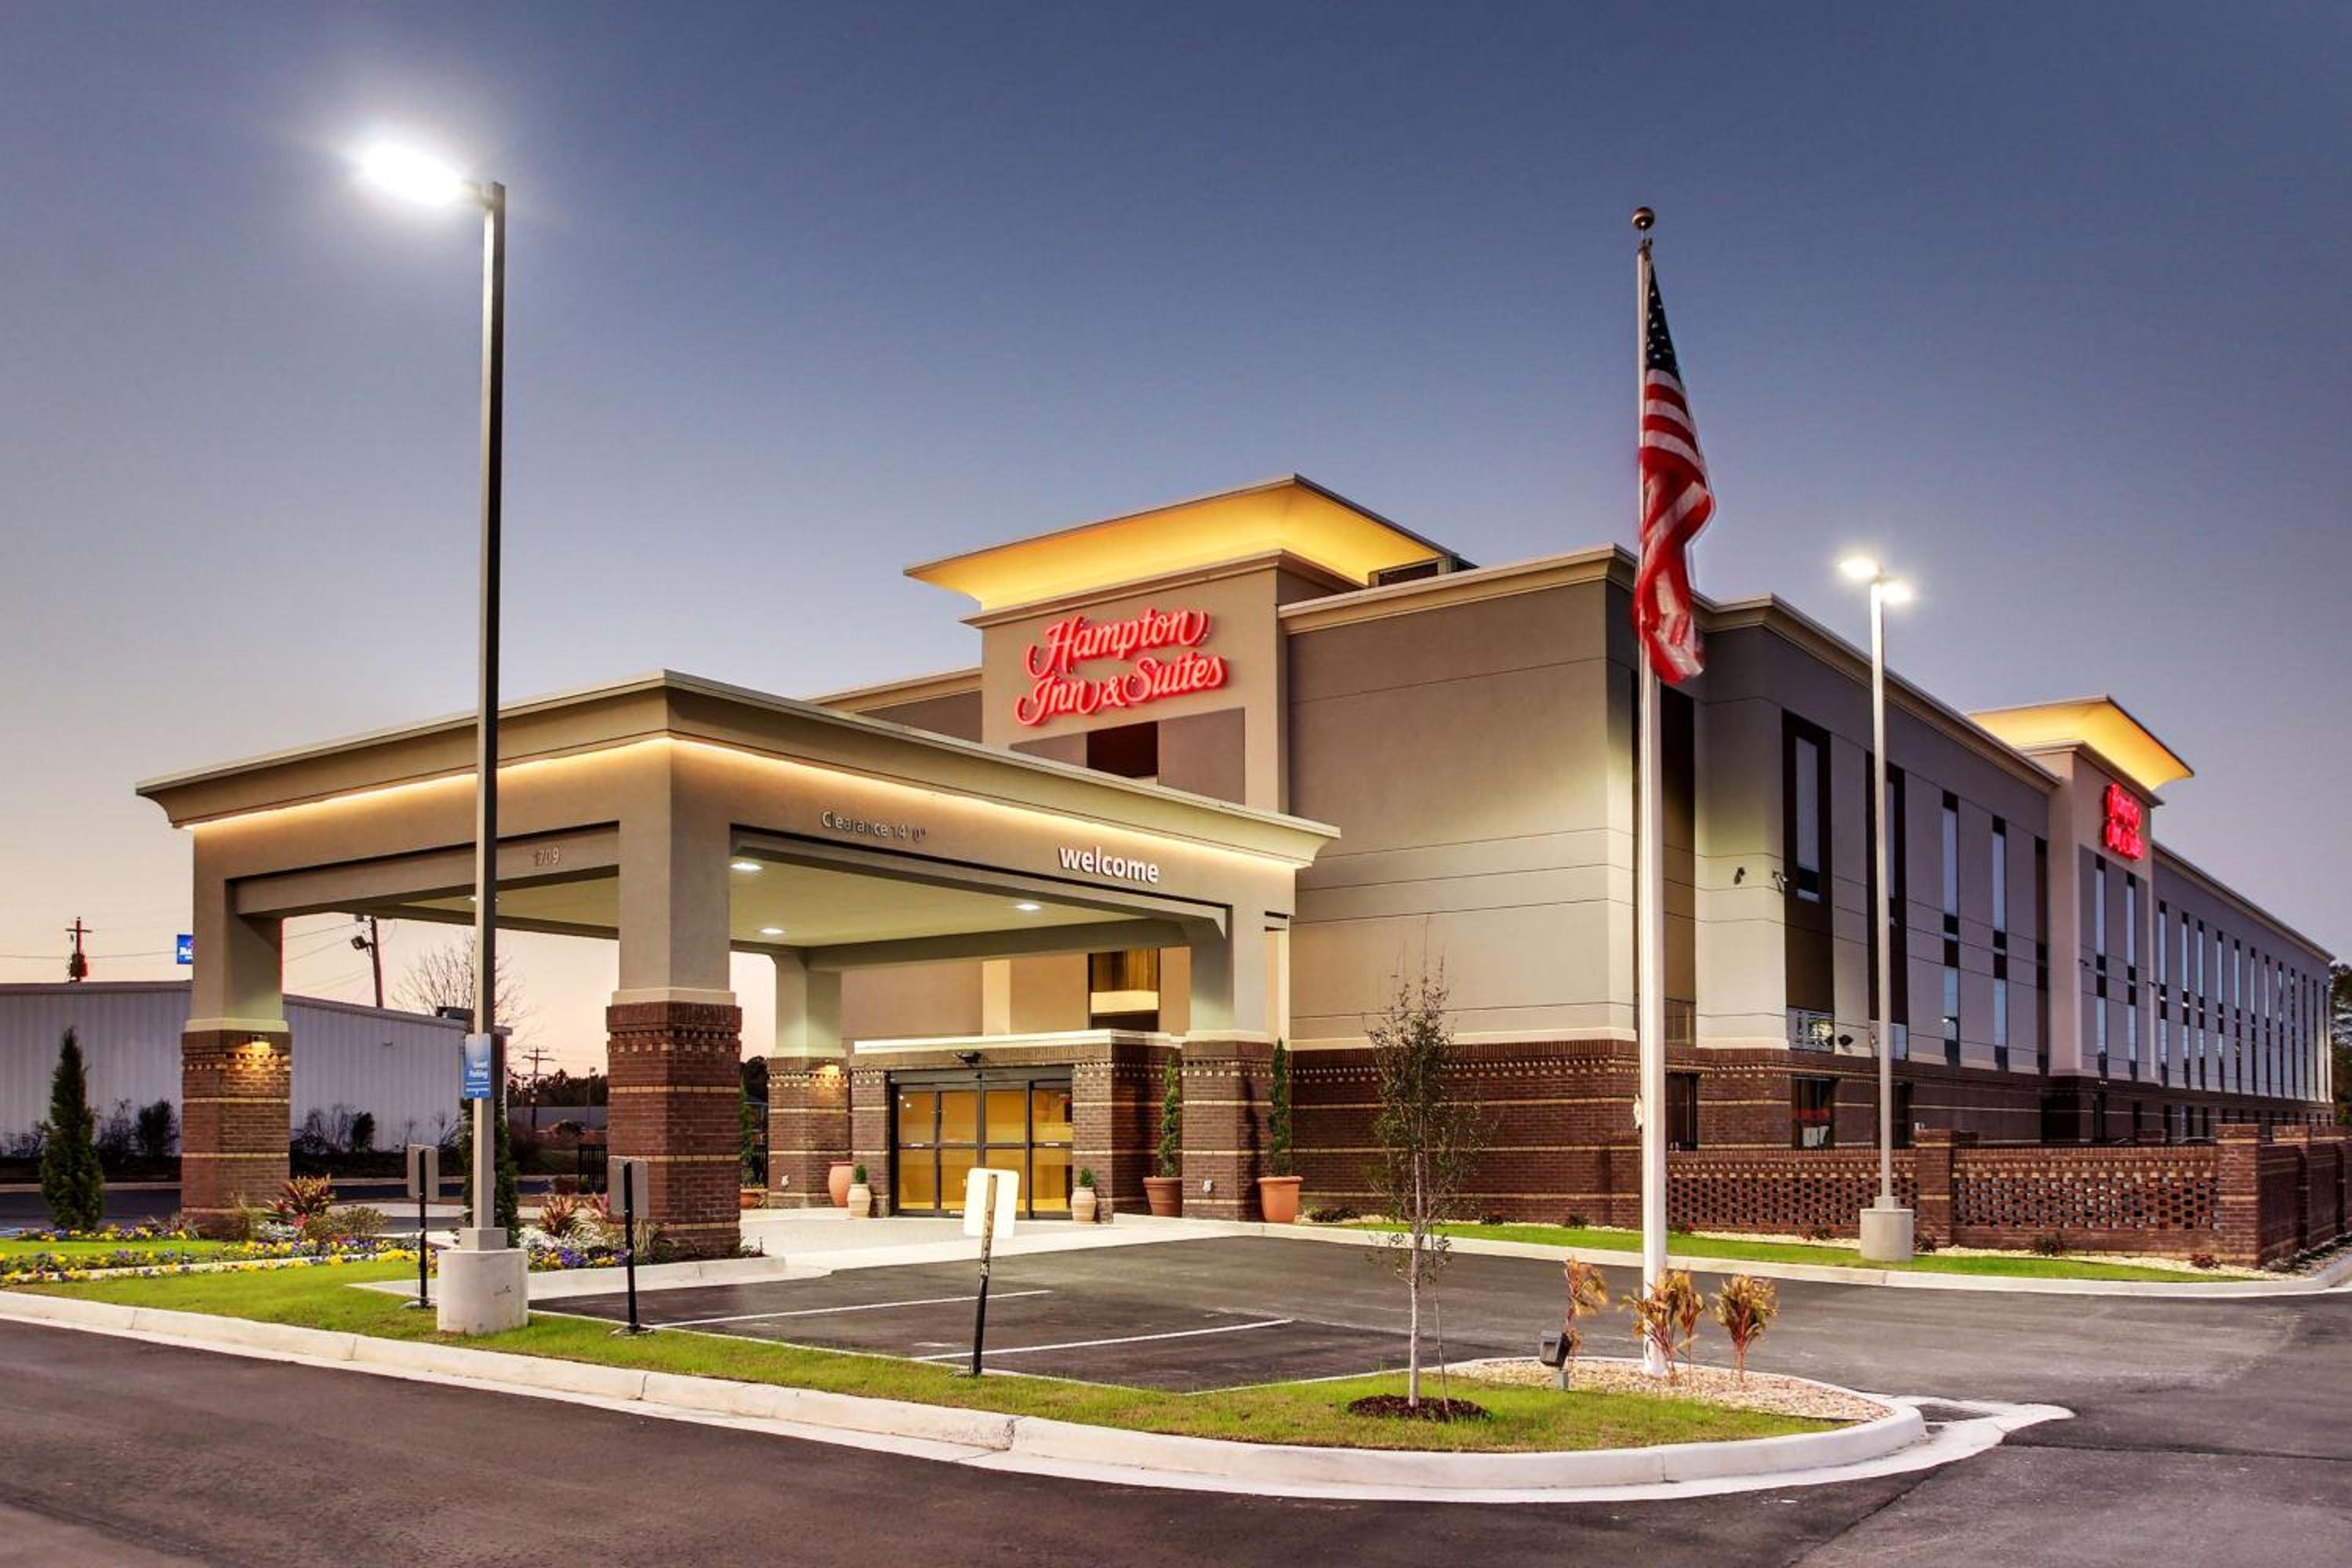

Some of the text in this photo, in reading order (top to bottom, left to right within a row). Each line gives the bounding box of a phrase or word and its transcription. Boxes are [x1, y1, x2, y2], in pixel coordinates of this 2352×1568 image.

[1026, 608, 1210, 677] Hampton
[1015, 652, 1229, 726] Inn & Suites
[822, 811, 889, 837] Clearance
[1058, 845, 1159, 884] welcome
